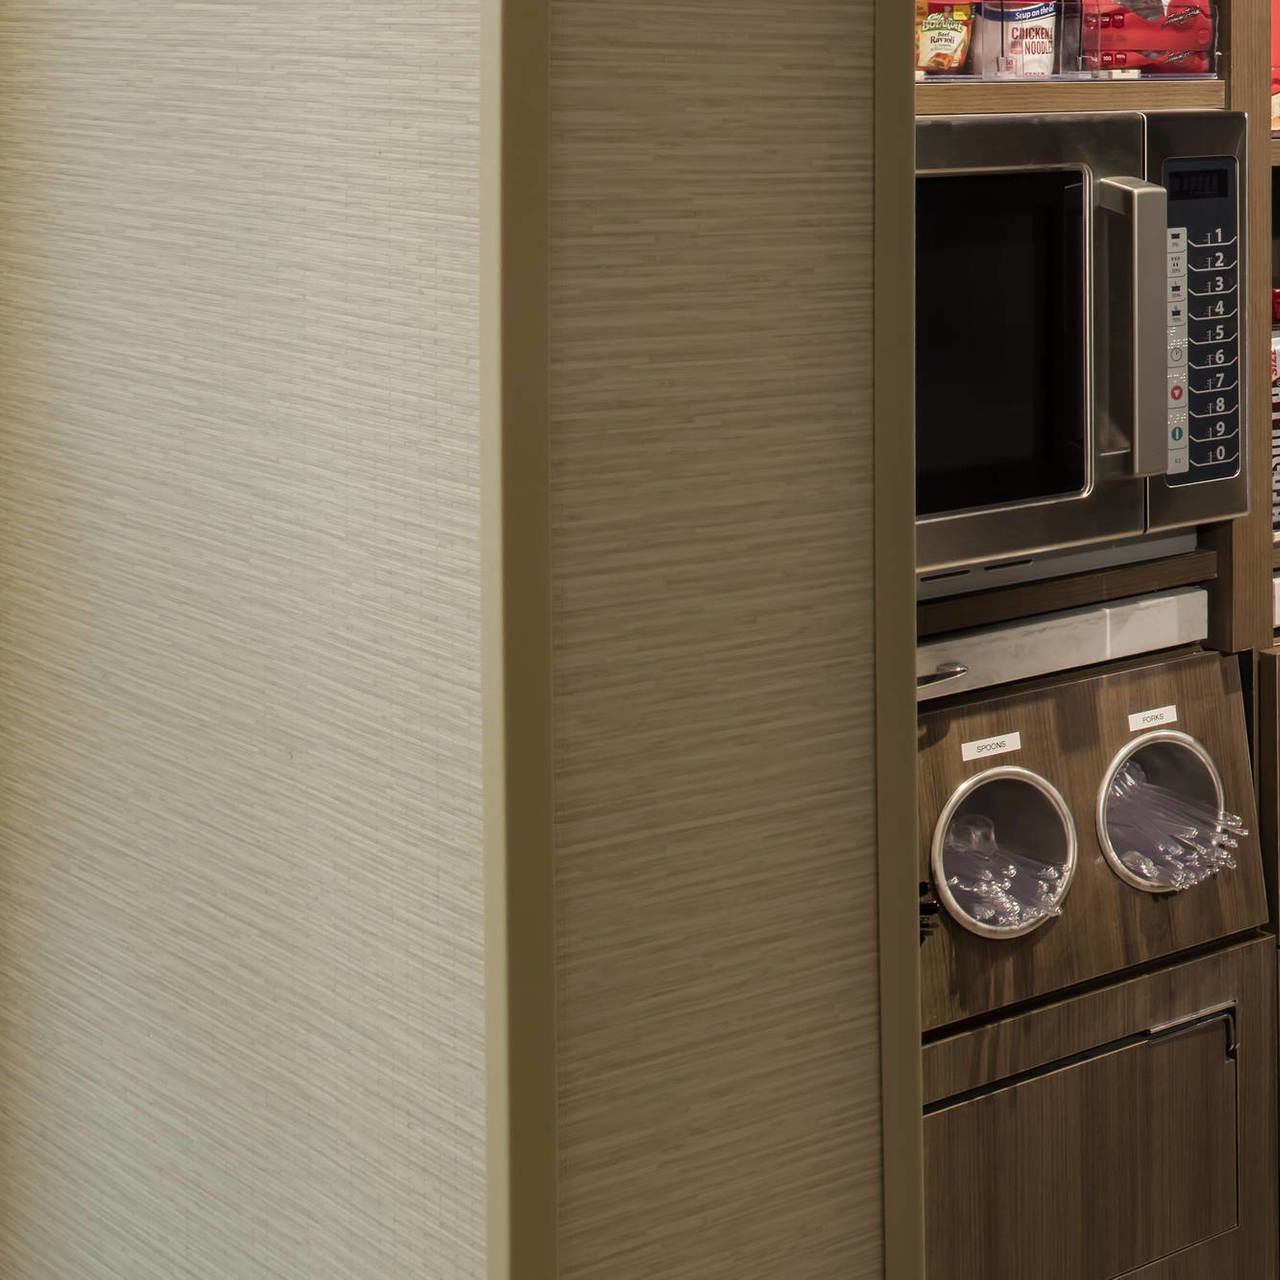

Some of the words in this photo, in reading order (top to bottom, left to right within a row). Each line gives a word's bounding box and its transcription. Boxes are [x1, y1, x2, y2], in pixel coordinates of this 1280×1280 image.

[1011, 26, 1053, 41] CHICKEN
[1215, 252, 1225, 268] 2
[1215, 276, 1225, 292] 3
[1215, 300, 1225, 316] 4
[1215, 325, 1225, 340] 5
[1215, 349, 1225, 364] 6
[1216, 373, 1225, 389] 7
[1216, 397, 1226, 413] 8
[1216, 421, 1226, 437] 9
[1216, 445, 1226, 461] 0
[1142, 712, 1166, 725] FORKS
[976, 739, 1008, 754] SPOONS
